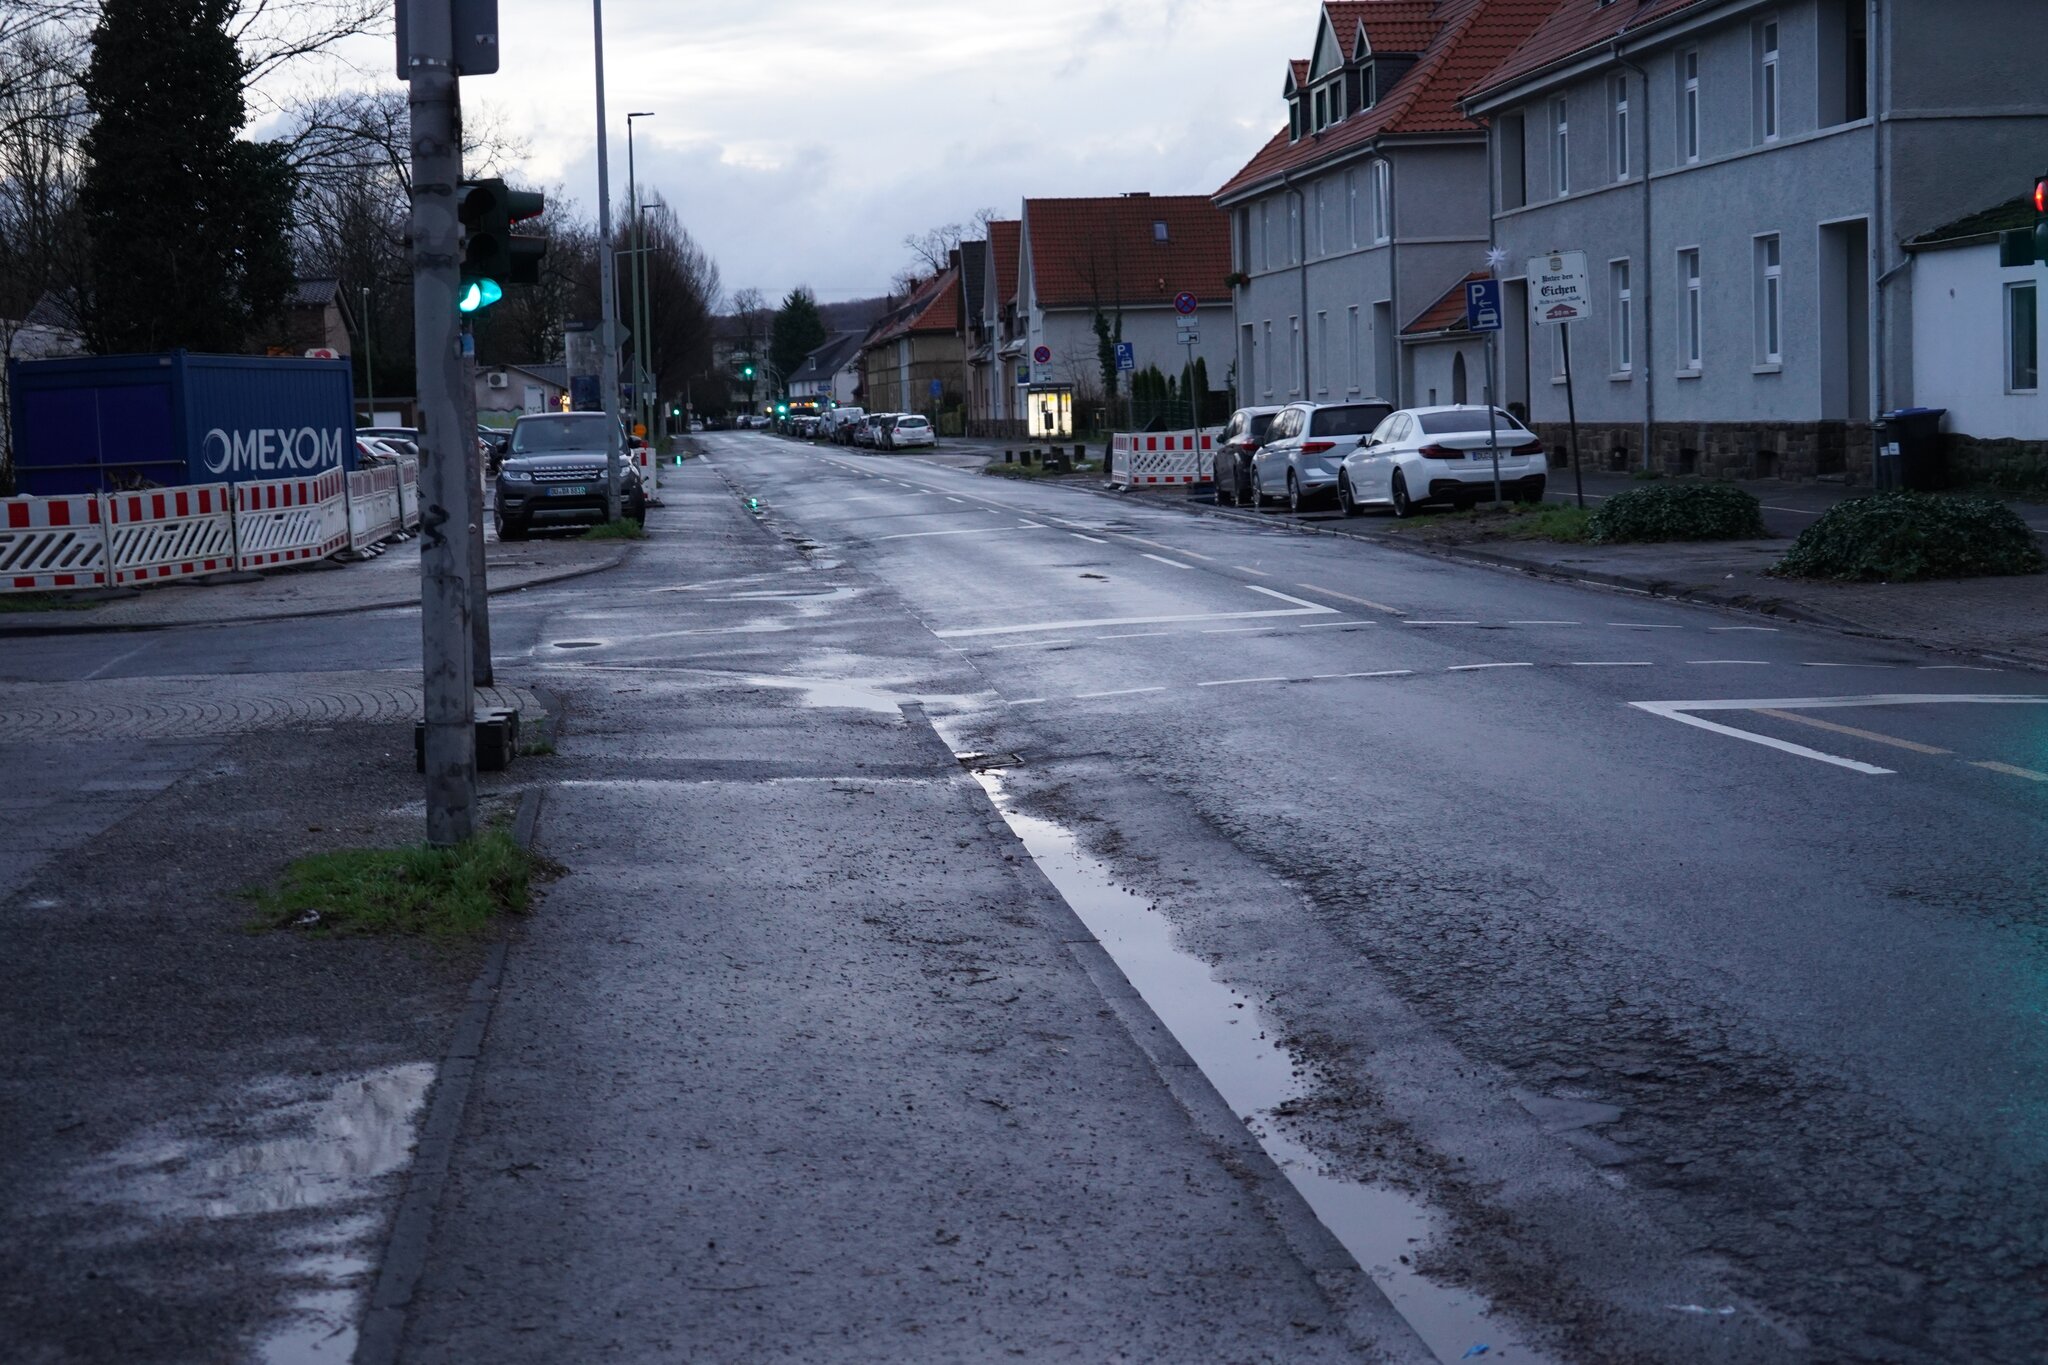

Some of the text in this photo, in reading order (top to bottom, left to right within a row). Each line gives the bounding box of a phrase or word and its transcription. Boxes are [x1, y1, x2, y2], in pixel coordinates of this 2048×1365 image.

[1471, 284, 1485, 305] P
[1541, 284, 1577, 297] Eichen
[1117, 344, 1126, 356] P
[203, 426, 343, 474] OMEXOM
